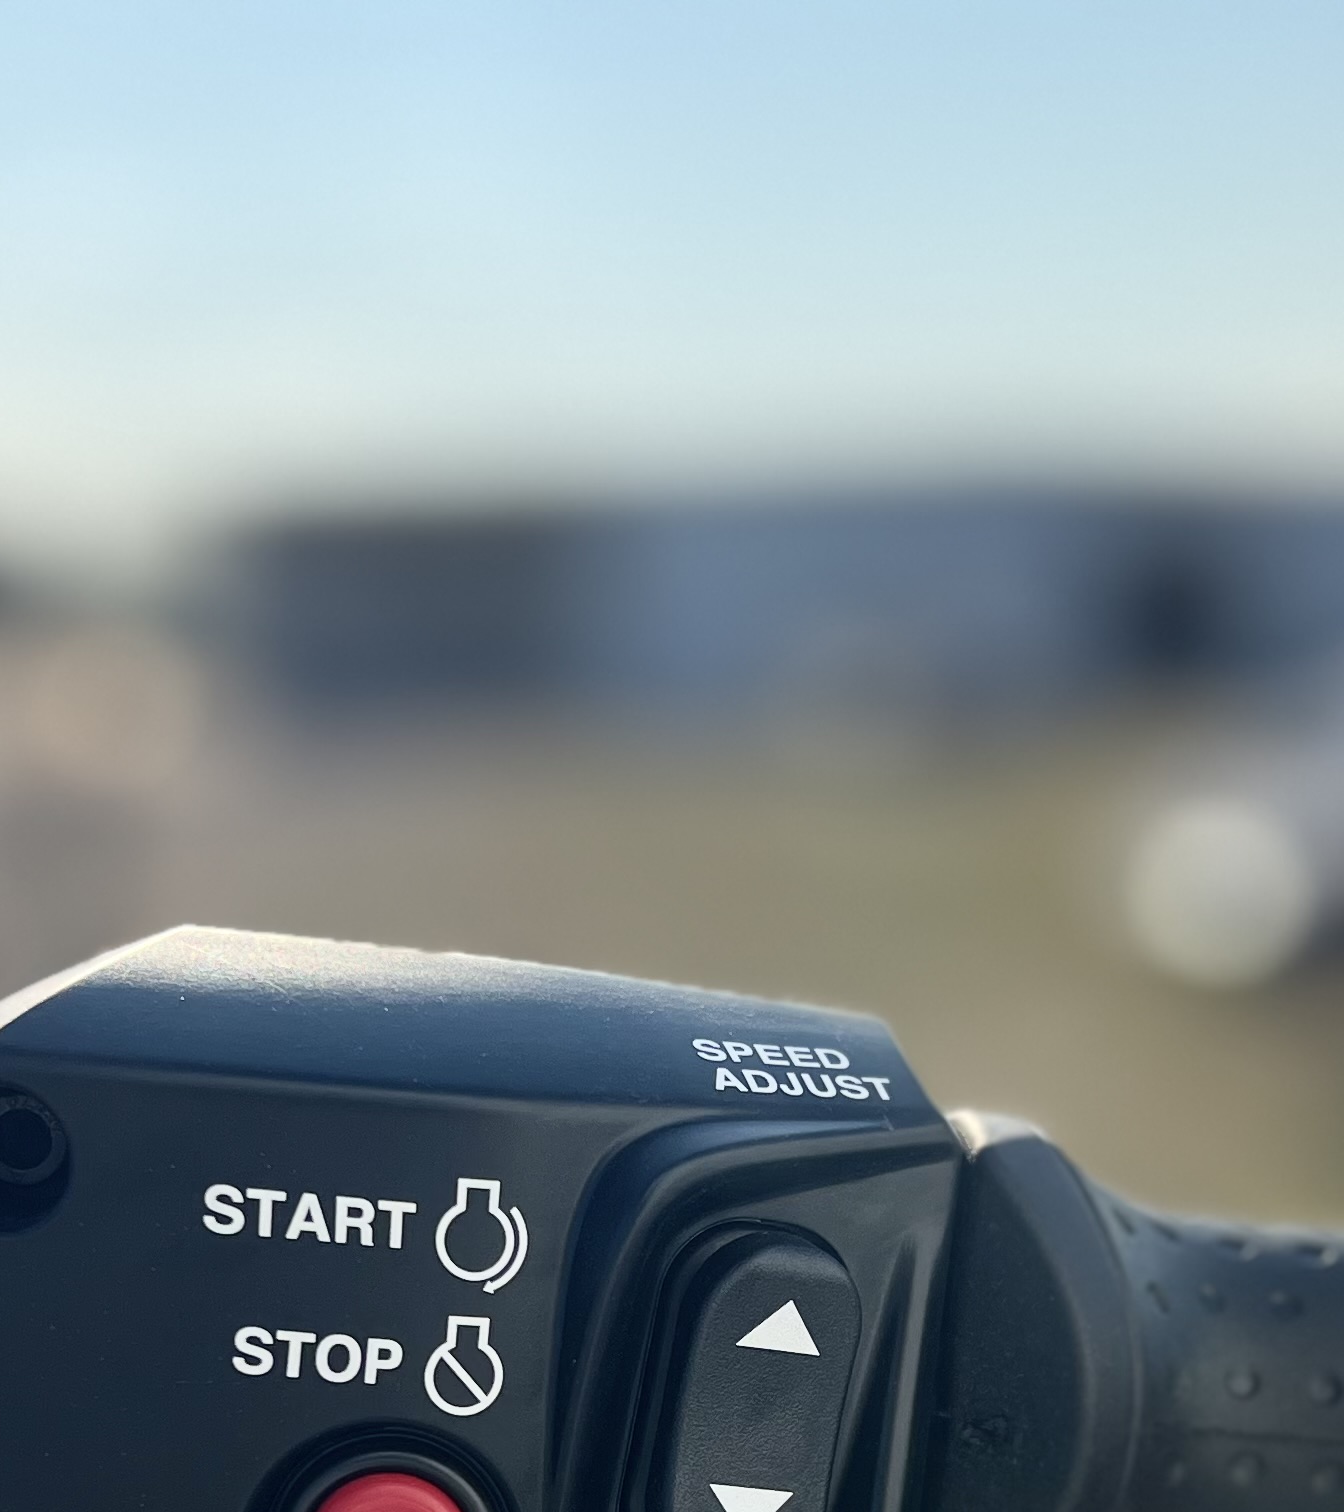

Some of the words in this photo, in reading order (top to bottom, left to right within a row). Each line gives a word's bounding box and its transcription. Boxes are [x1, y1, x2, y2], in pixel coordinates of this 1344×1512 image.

[692, 1038, 850, 1070] SPEED
[715, 1067, 891, 1101] ADJUST
[202, 1183, 417, 1249] START
[231, 1326, 403, 1385] STOP
